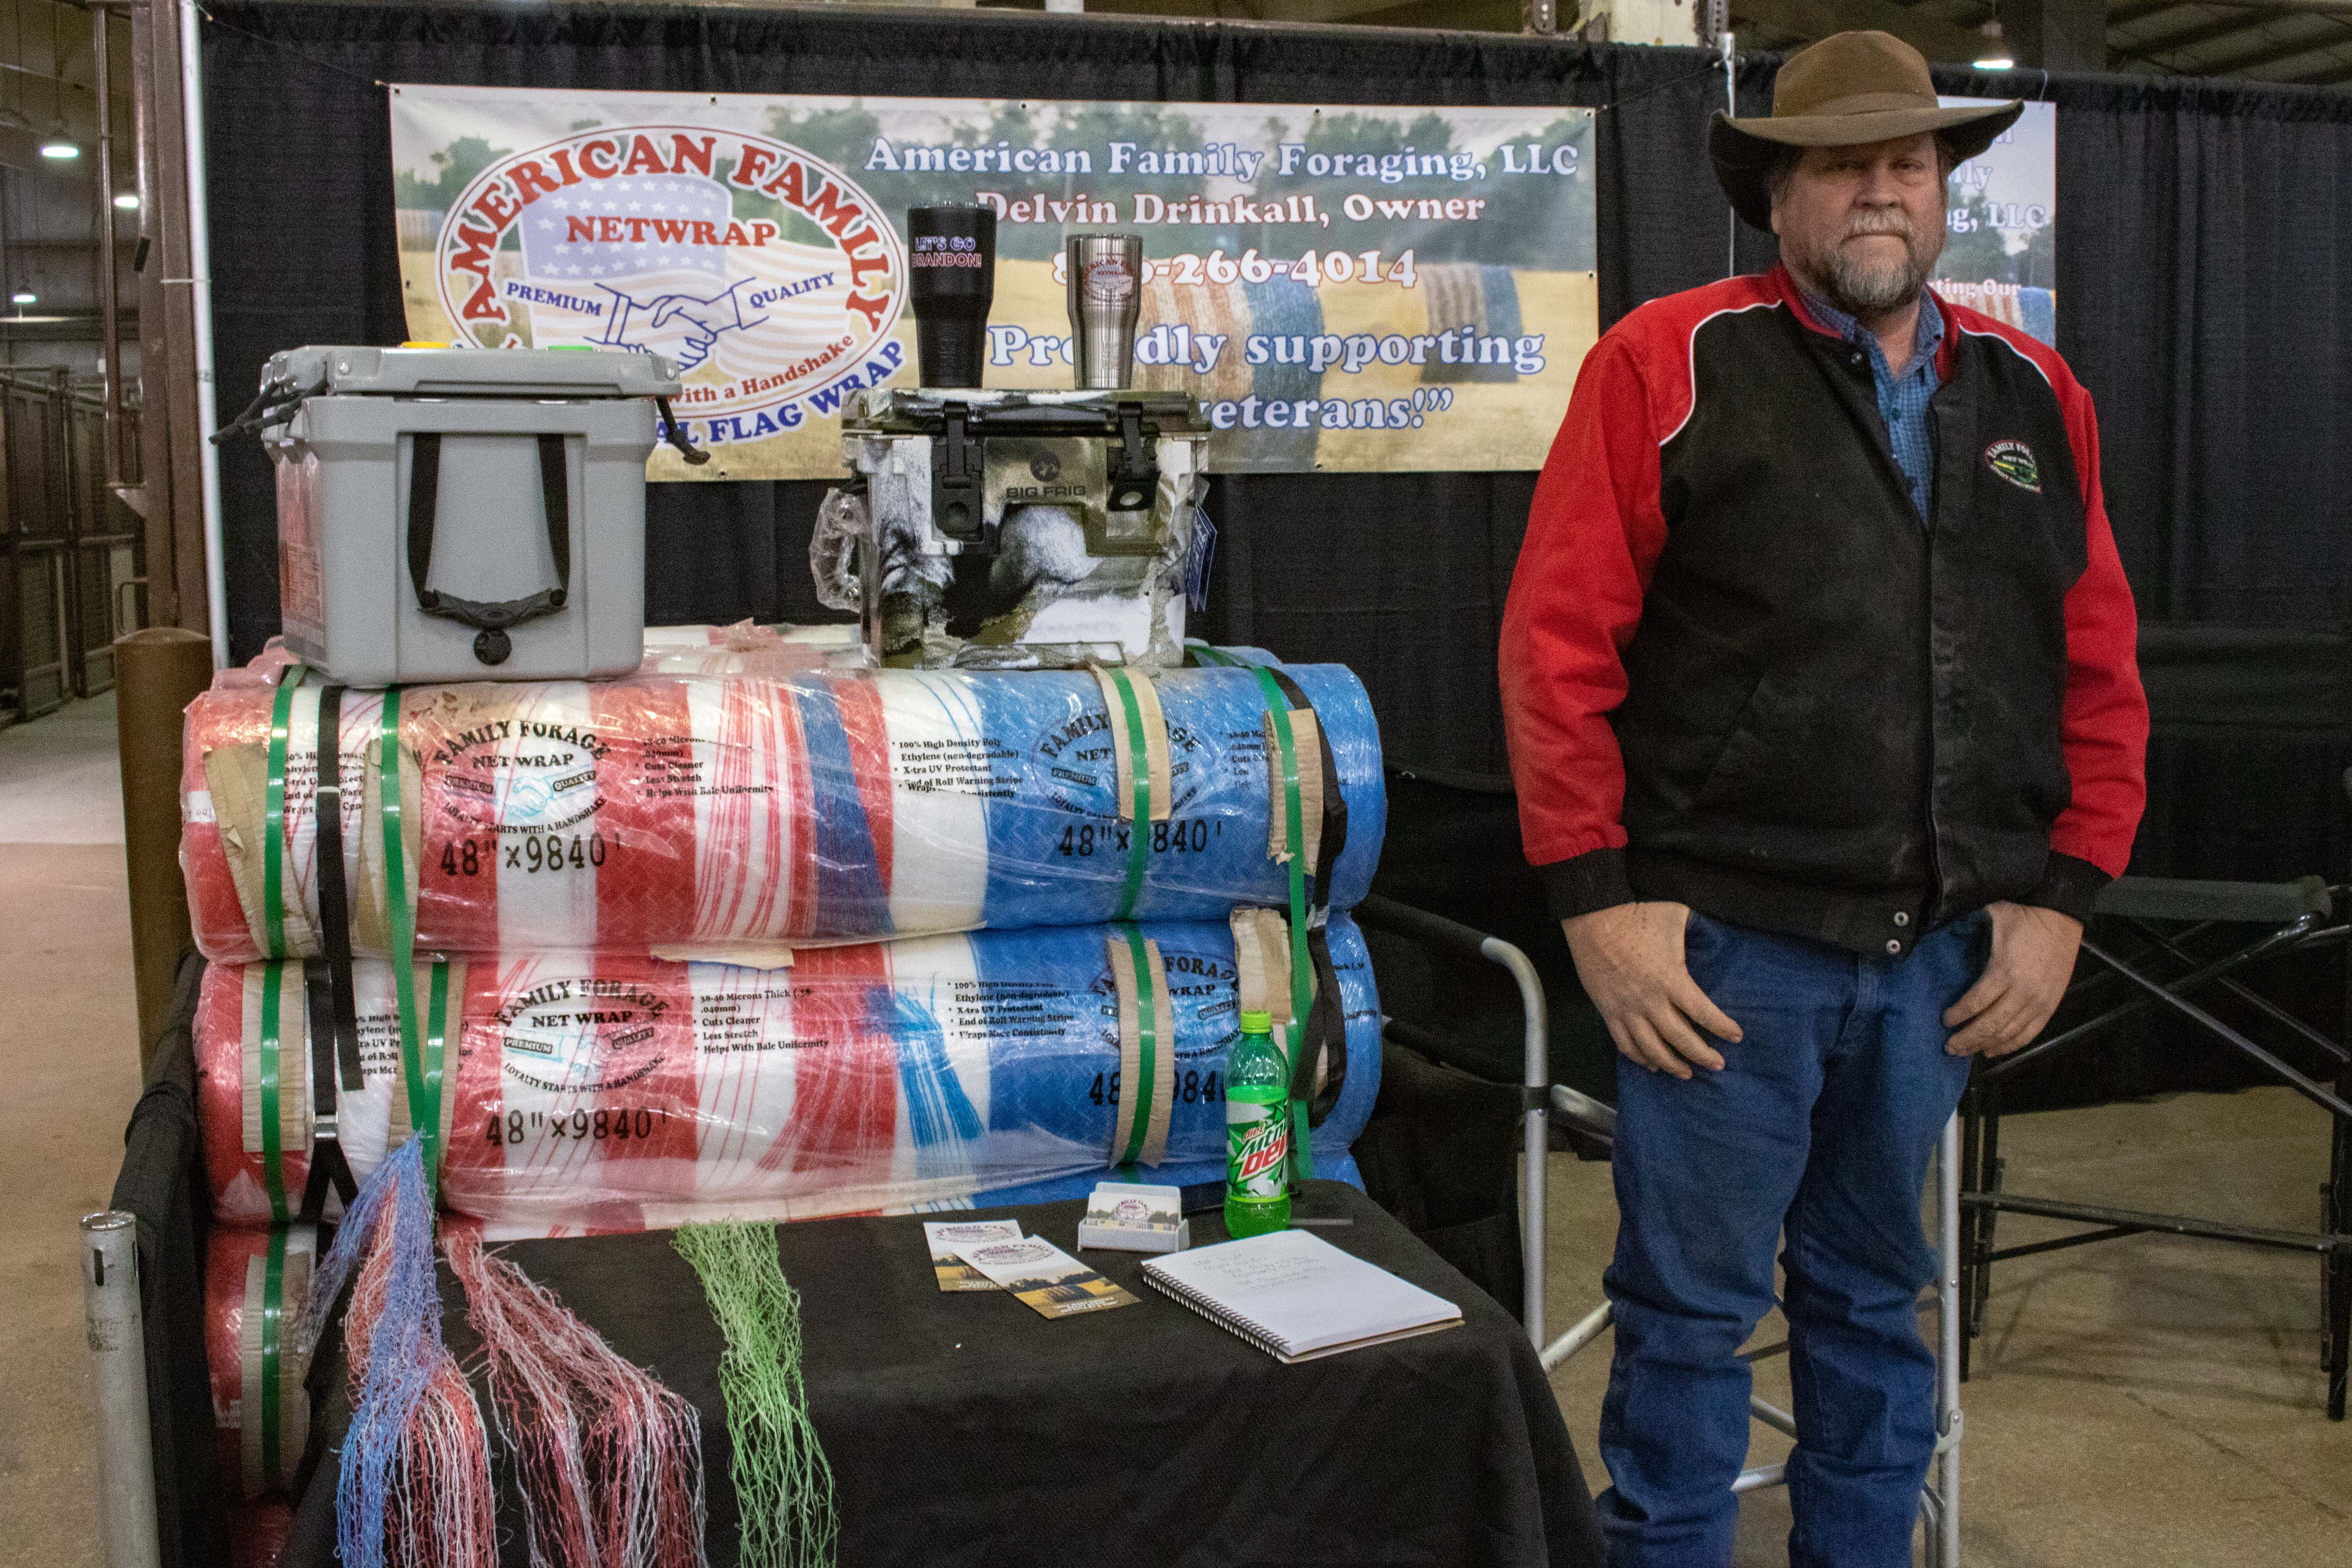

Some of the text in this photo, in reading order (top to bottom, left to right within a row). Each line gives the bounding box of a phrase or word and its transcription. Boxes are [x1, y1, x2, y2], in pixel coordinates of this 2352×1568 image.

[864, 136, 1579, 184] American Family Foraging, LLC
[976, 192, 1485, 228] Delvin Drinkall, Owner
[1986, 202, 2047, 229] LLC
[451, 133, 891, 332] AMERICAN FAMILY
[566, 215, 779, 247] NETWRAP
[915, 236, 976, 252] LET'S GO
[911, 252, 982, 268] BRANDON!
[749, 271, 836, 309] QUALITY
[506, 281, 603, 317] PREMIUM
[1245, 323, 1546, 376] supporting
[724, 387, 736, 399] a
[742, 335, 853, 394] Handshake
[708, 404, 803, 442] FLAG
[809, 340, 903, 414] WRAP
[1006, 485, 1087, 498] BIG FRIG
[432, 720, 611, 765] FAMILY FORAGE
[923, 741, 945, 750] High
[946, 739, 980, 749] Density
[1039, 713, 1110, 759] FAMILY
[472, 753, 574, 769] NET WRAP
[901, 749, 1019, 762] Ethylene (non-degradable)
[1075, 747, 1111, 762] NET
[903, 763, 992, 775] X-tra UV Protectant
[935, 777, 953, 786] Roll
[956, 776, 994, 786] Warning
[519, 825, 544, 834] WITH
[547, 823, 553, 832] A
[555, 796, 607, 830] HANDSHAKE
[494, 979, 572, 1027] FAMILY
[726, 993, 762, 1001] Microns
[764, 989, 791, 999] Thick
[955, 993, 994, 1003] Ethylene
[531, 1011, 633, 1028] NET WRAP
[702, 1016, 761, 1026] Cuts Cleaner
[372, 1038, 388, 1048] UV
[703, 1030, 758, 1041] Less Stretch
[504, 1037, 553, 1054] PREMIUM
[704, 1039, 829, 1054] Helps With Bale Uniformity
[504, 1062, 542, 1088] LOYALTY
